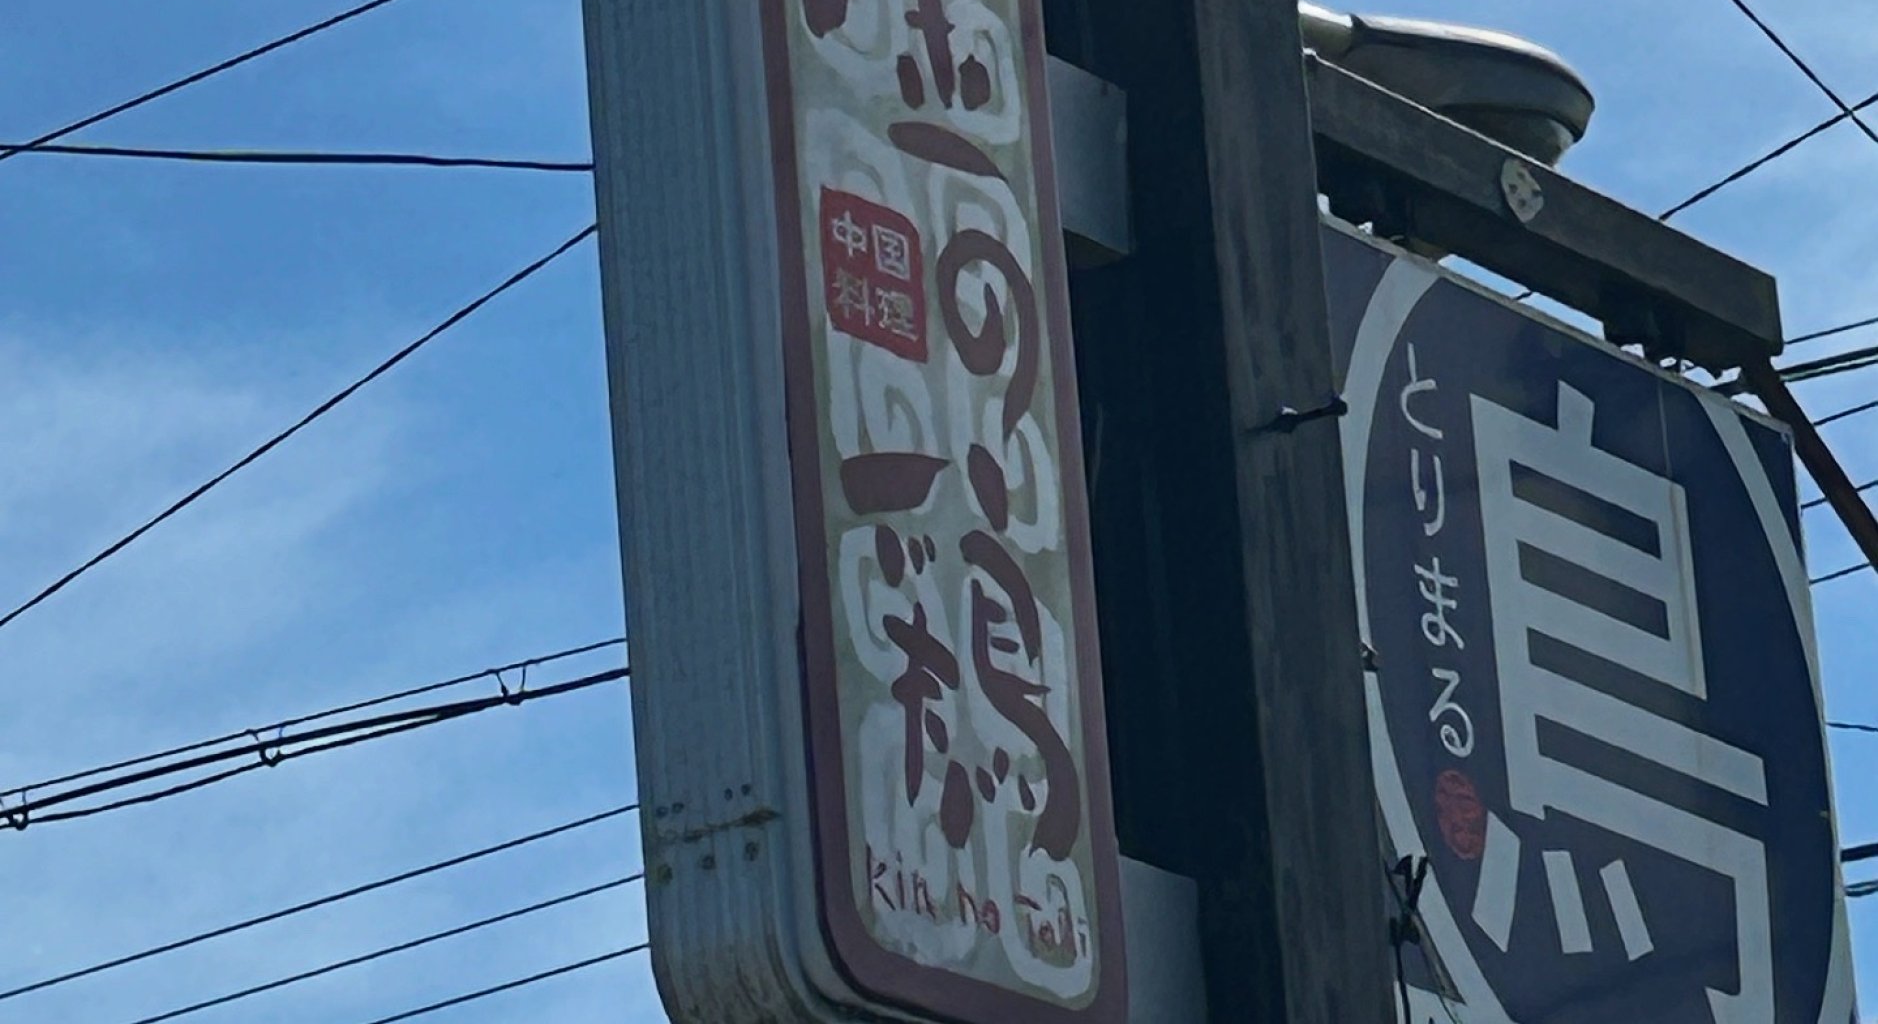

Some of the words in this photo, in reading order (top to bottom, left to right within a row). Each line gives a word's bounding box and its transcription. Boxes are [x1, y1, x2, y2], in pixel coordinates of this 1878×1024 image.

[831, 209, 911, 281] 中国
[831, 266, 919, 342] 料理
[1400, 342, 1474, 759] とりまる
[1469, 379, 1776, 1024] 鳥
